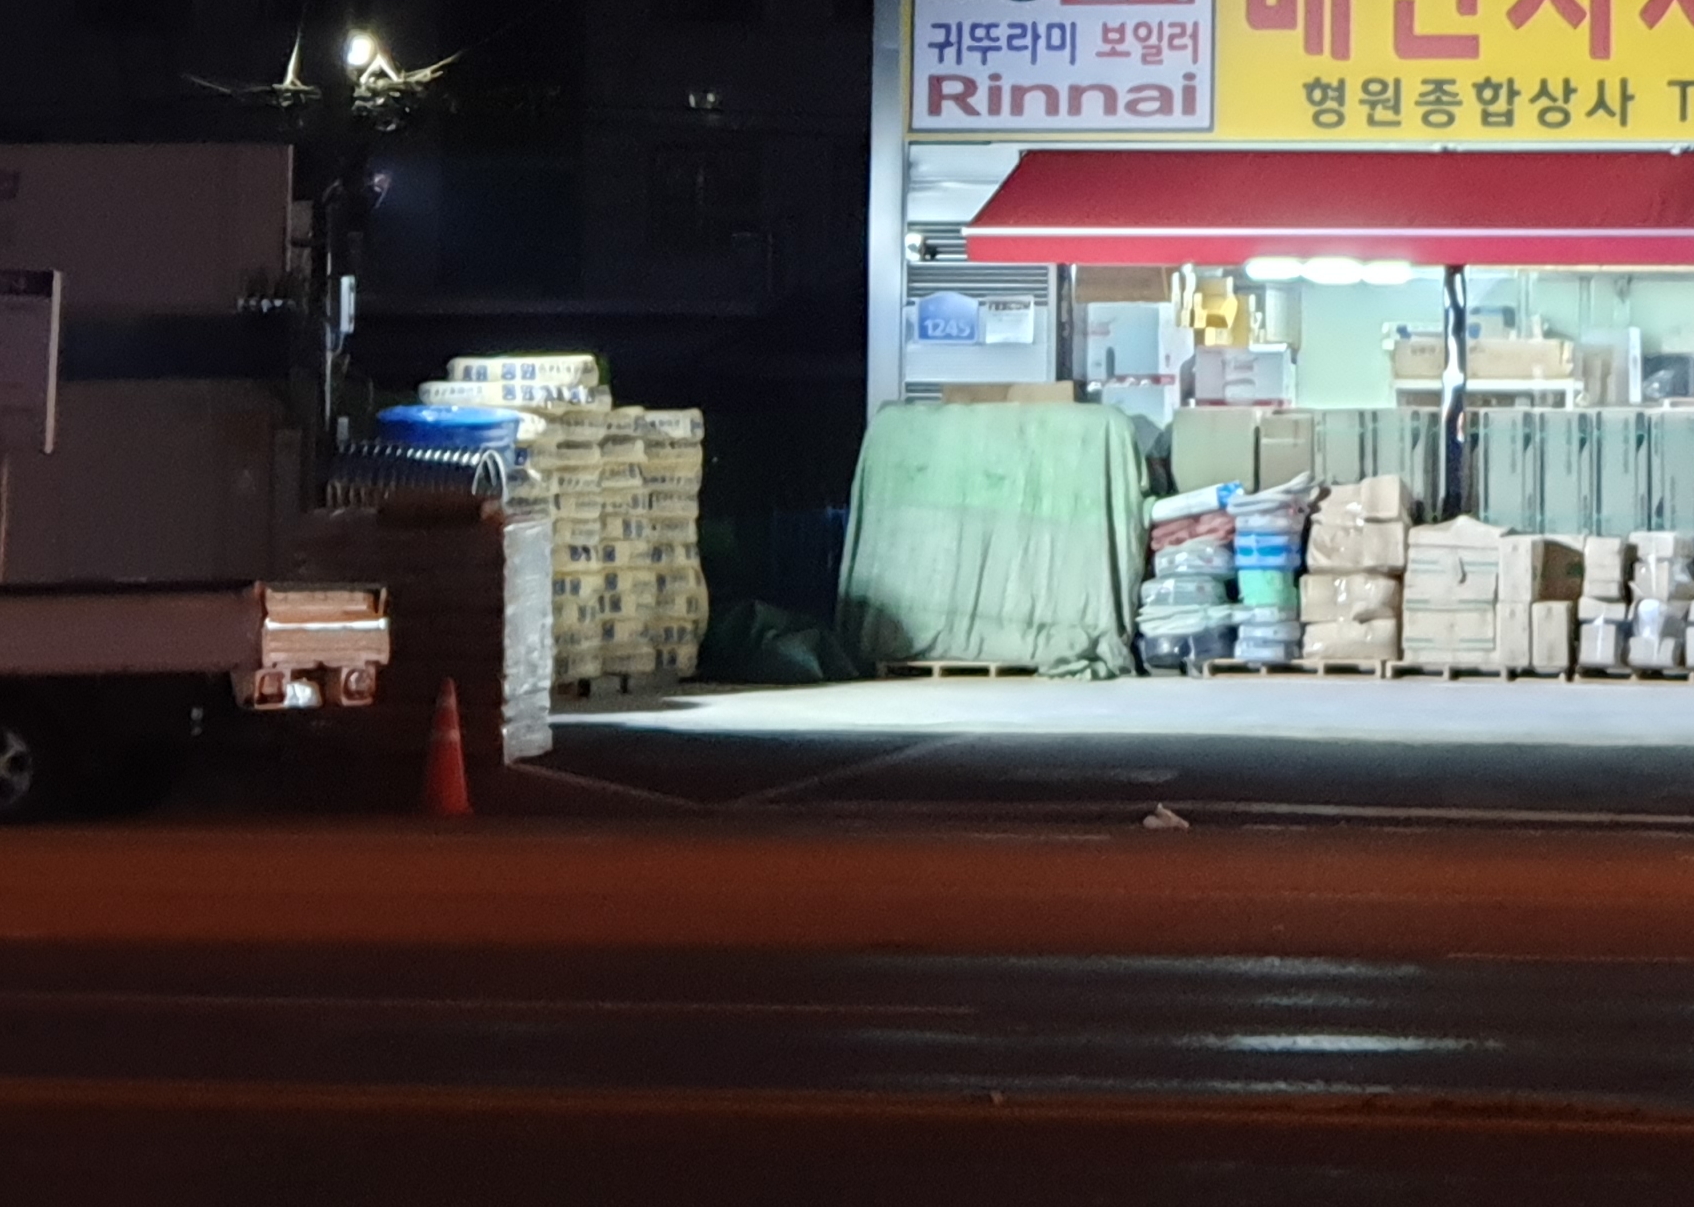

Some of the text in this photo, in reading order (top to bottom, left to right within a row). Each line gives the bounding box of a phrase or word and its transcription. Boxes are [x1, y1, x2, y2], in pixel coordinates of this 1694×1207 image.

[927, 20, 1199, 66] 귀뚜라미 보일러
[927, 72, 1197, 117] Rinnai
[1302, 76, 1636, 129] 형원종합상사
